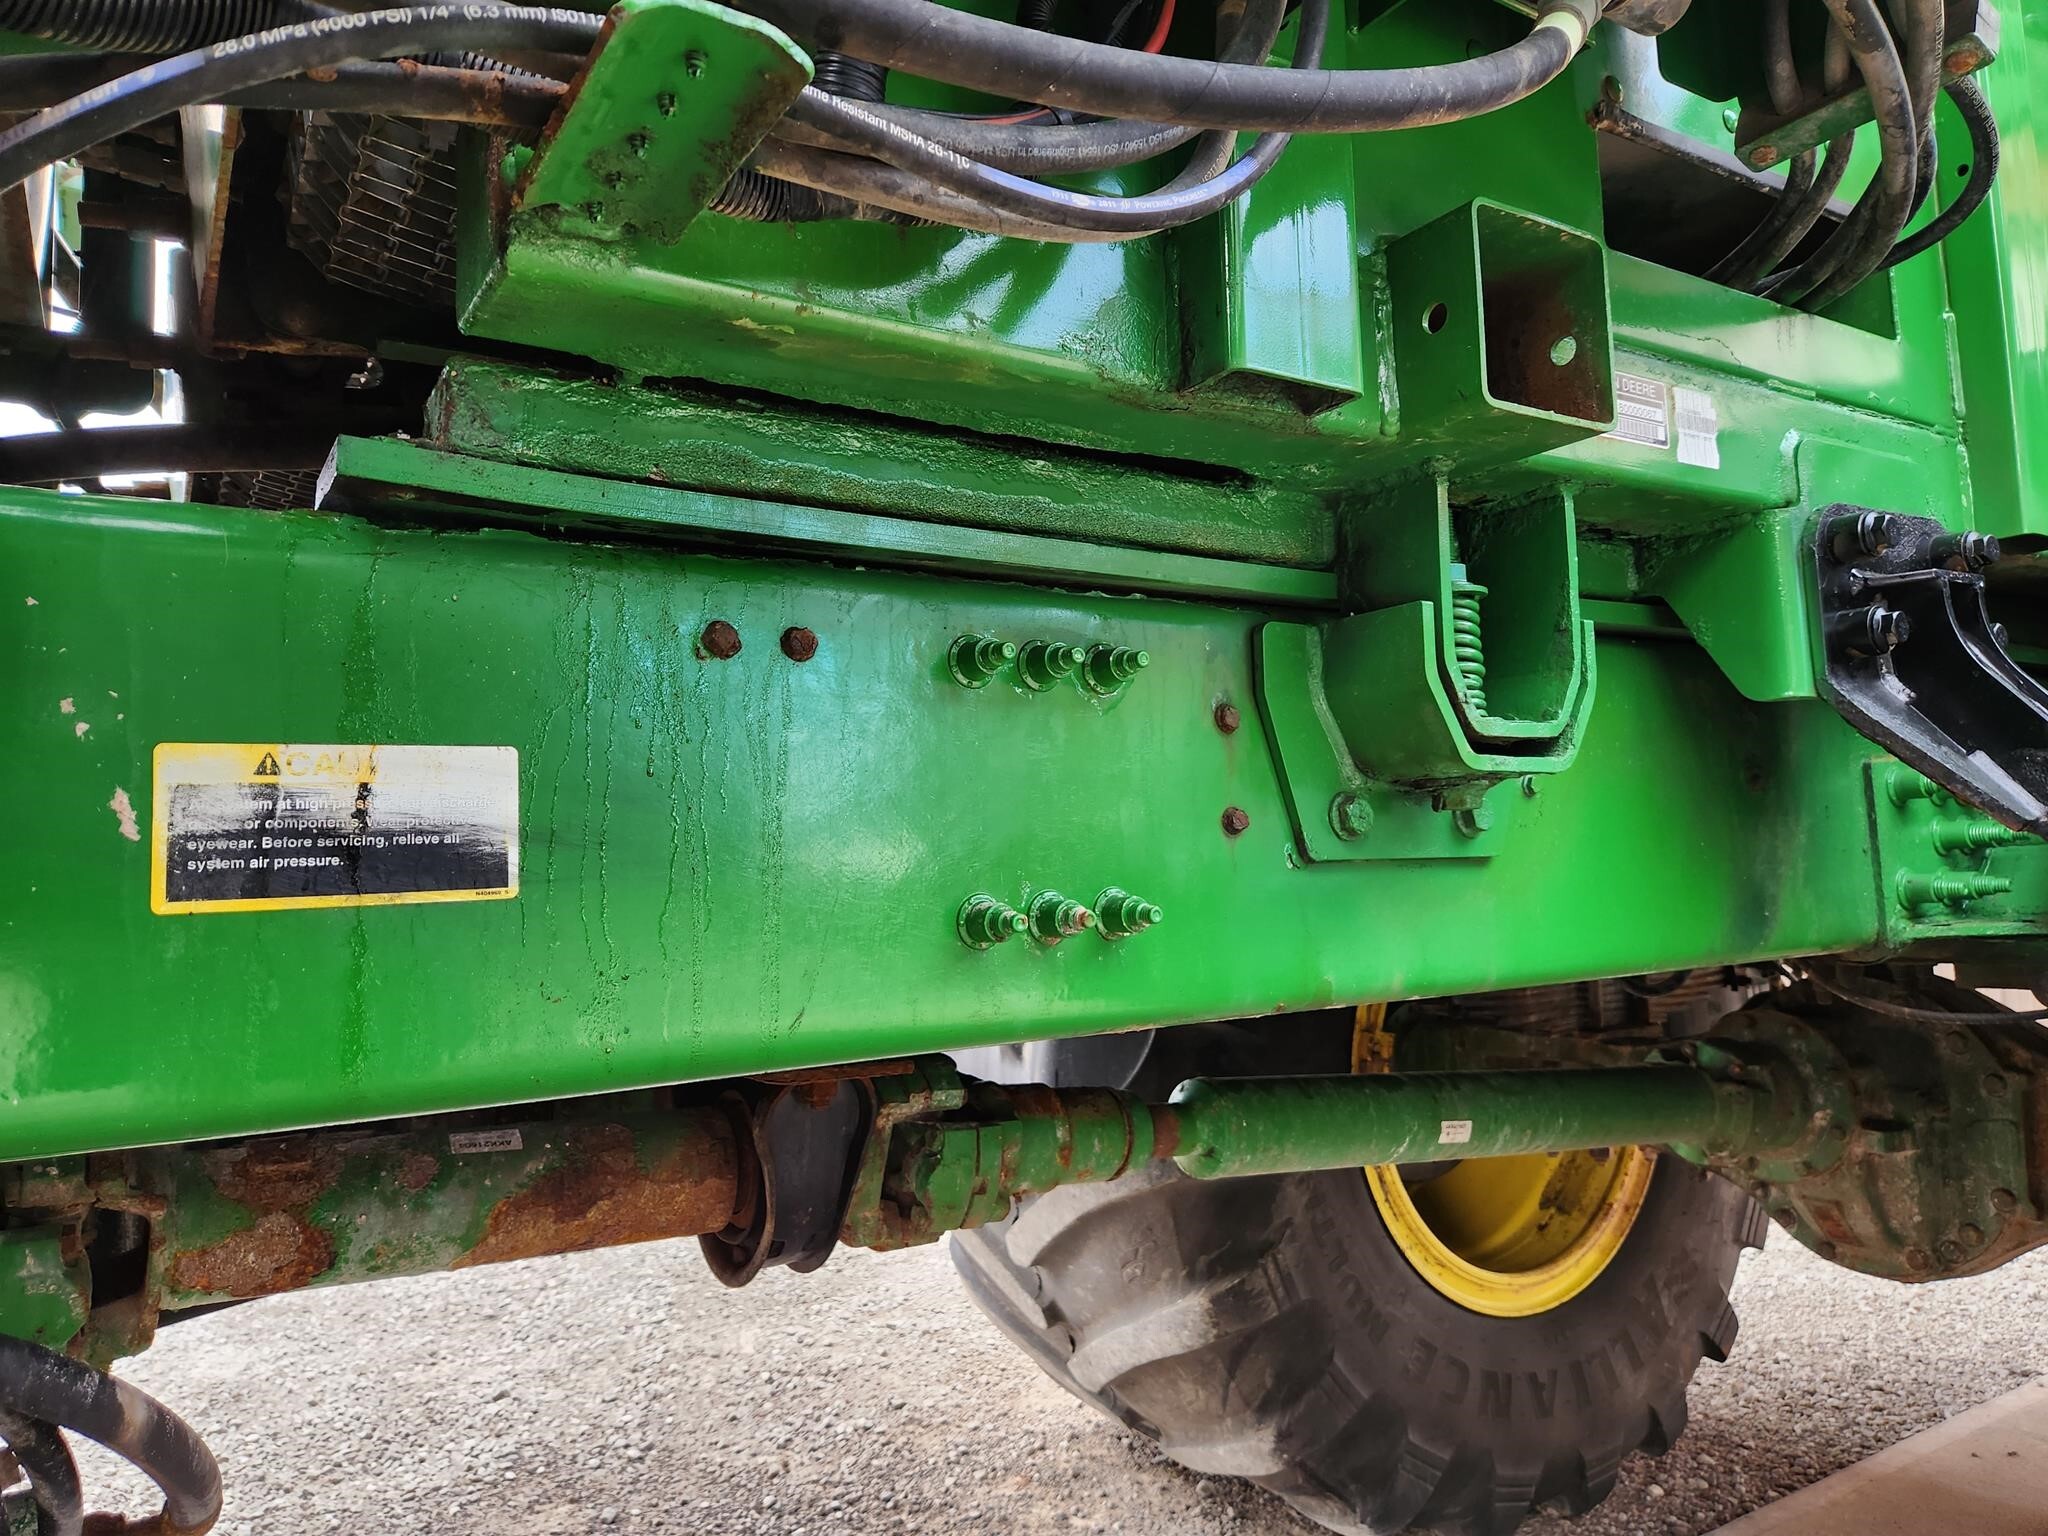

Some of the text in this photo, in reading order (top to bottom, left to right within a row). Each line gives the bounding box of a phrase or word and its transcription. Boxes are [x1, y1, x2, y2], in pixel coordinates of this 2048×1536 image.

[212, 34, 256, 58] 28.0
[260, 24, 308, 45] MPa
[311, 12, 367, 37] (4000
[371, 8, 412, 25] PSI)
[463, 5, 500, 21] (6.3
[505, 6, 547, 23] mm)
[801, 84, 829, 101] ame
[831, 95, 888, 131] Resistant
[890, 122, 925, 148] MSHA
[1622, 378, 1656, 398] DEERE
[244, 817, 260, 830] or
[187, 833, 460, 853] eyewear. Before servicing, relieve all
[187, 856, 344, 872] system air pressure.
